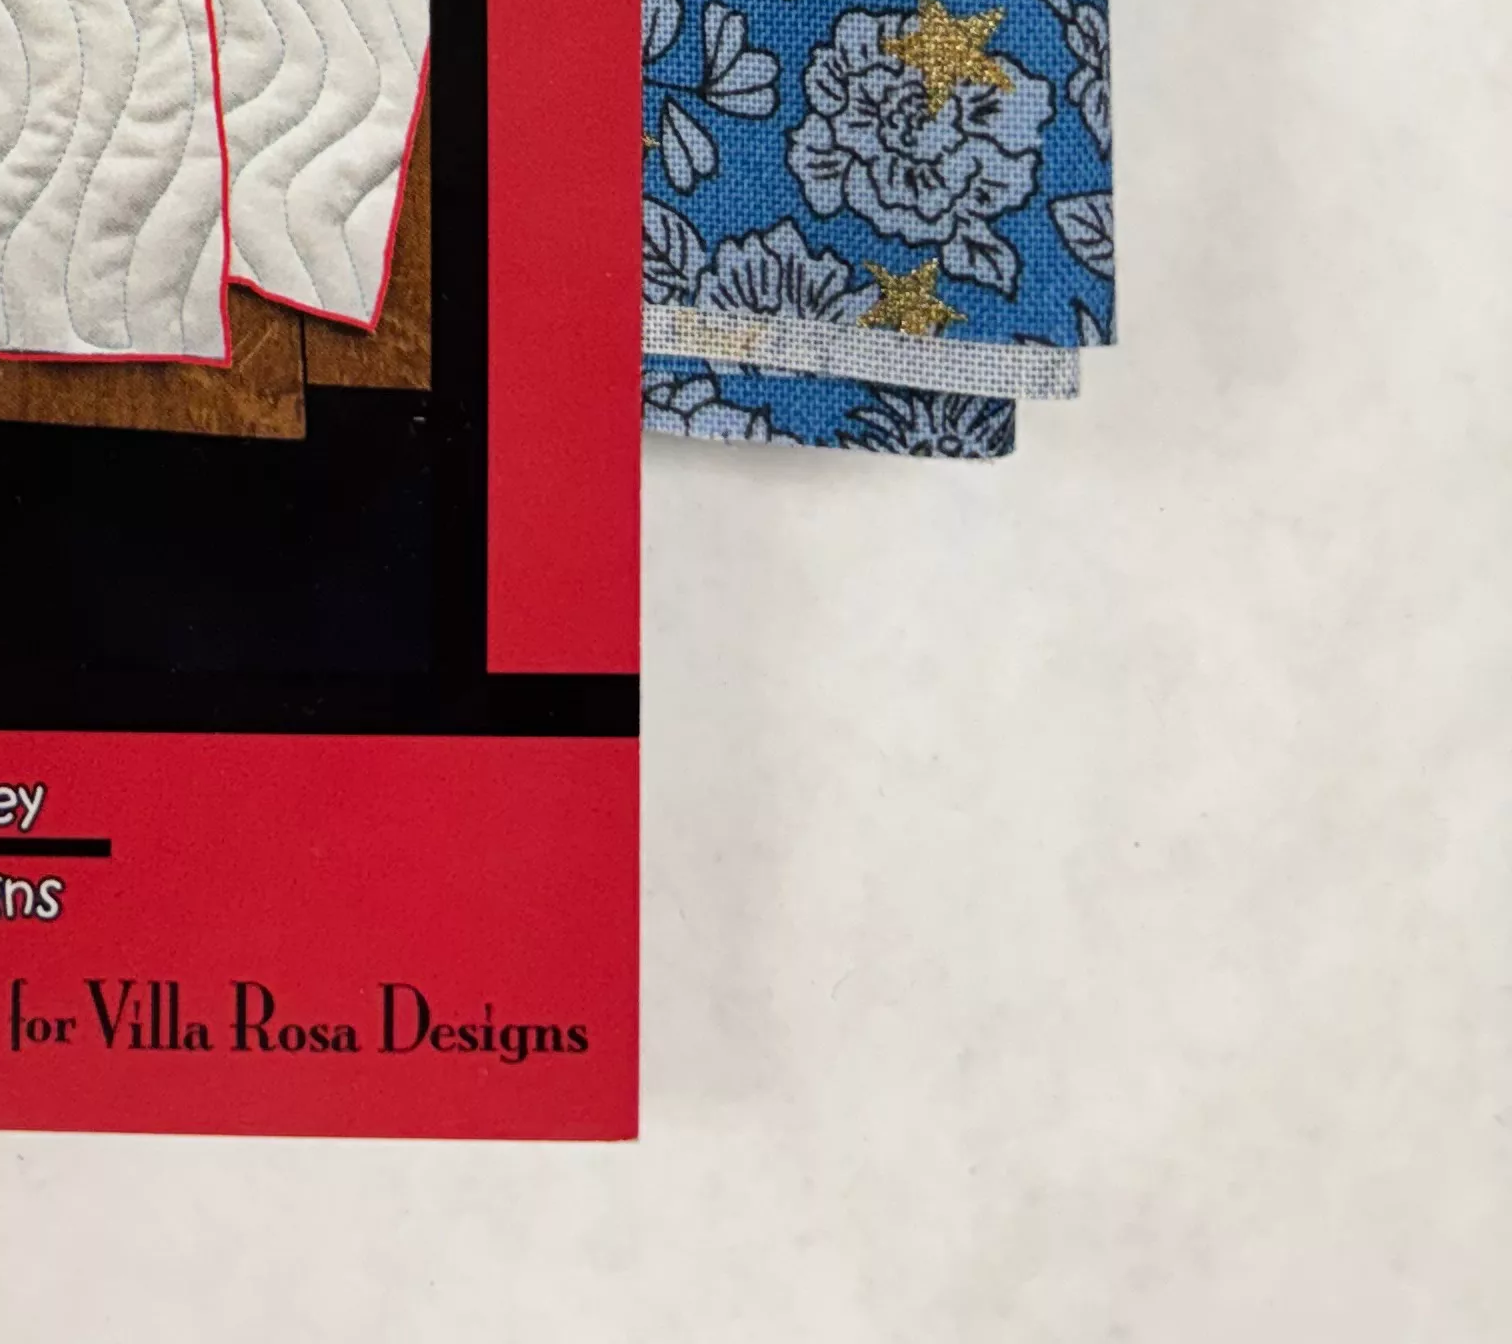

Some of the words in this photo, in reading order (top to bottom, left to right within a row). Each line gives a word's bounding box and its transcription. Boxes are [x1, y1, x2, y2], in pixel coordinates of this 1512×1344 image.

[10, 978, 77, 1052] for
[84, 979, 213, 1053] Villa
[229, 980, 361, 1054] Rosa
[377, 982, 589, 1063] Designs
